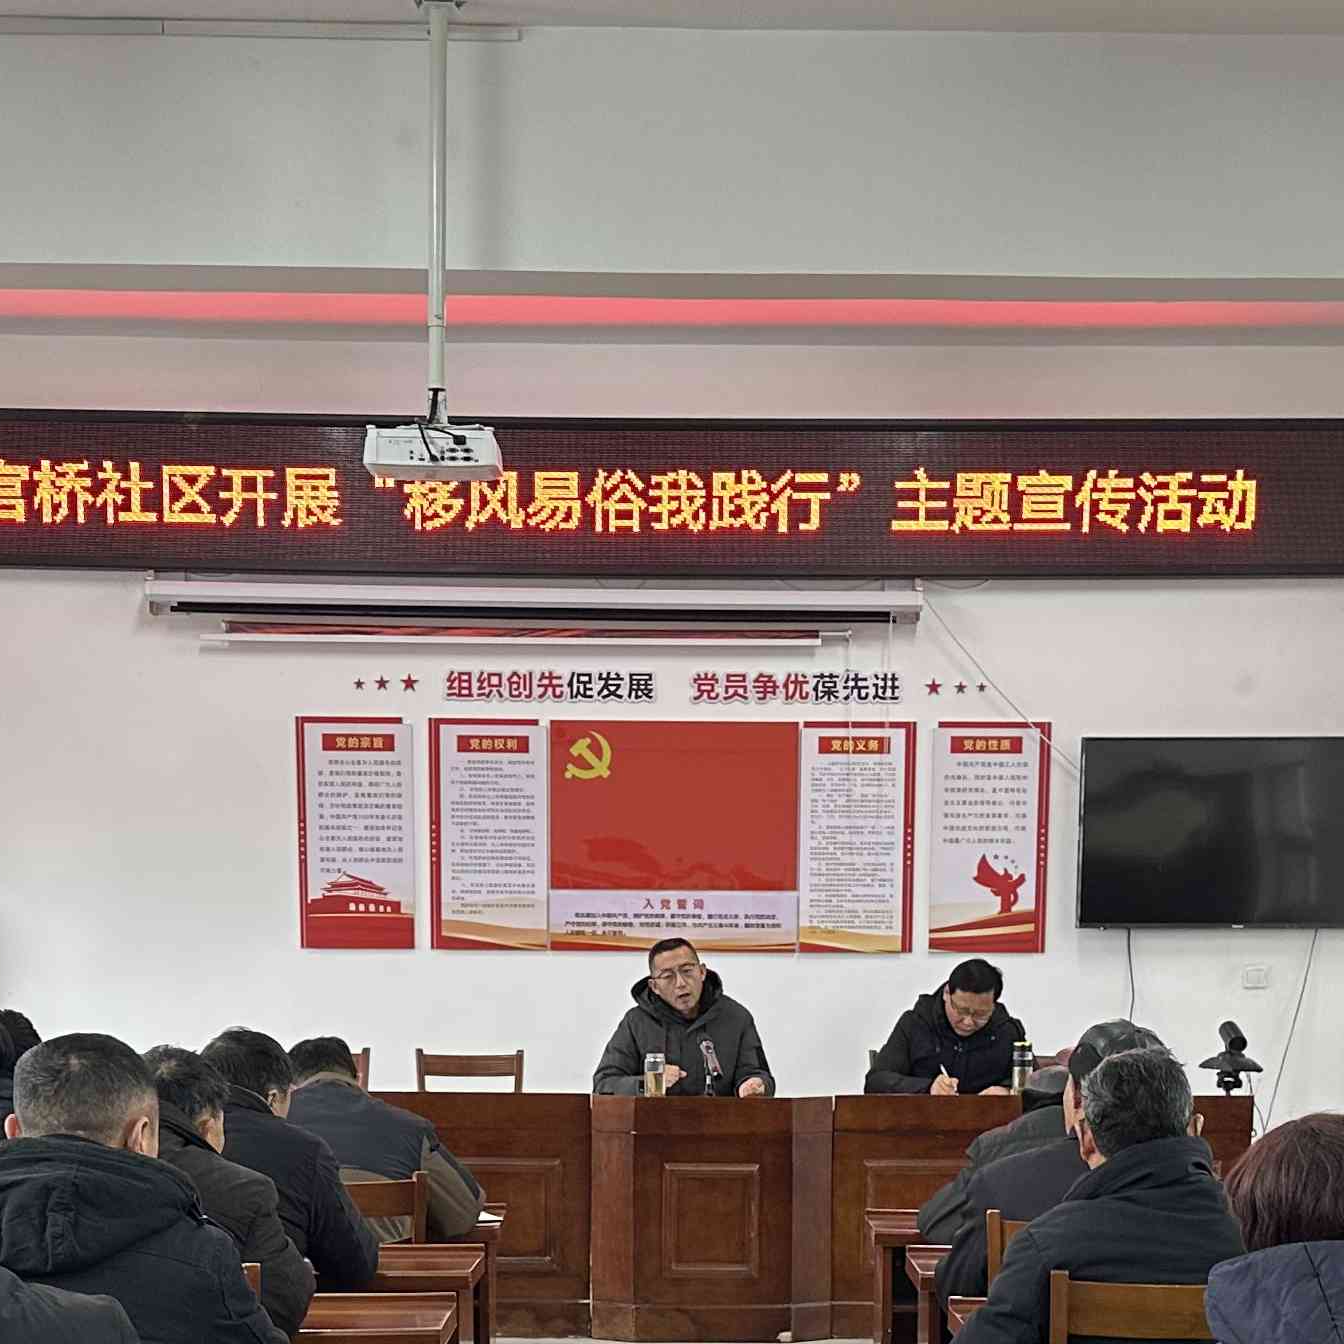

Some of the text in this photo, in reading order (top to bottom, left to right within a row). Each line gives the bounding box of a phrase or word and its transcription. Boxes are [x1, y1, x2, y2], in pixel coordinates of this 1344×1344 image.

[445, 670, 901, 703] 组织创先促发展 党员争优葆先进
[335, 737, 385, 749] 党的宗旨
[469, 738, 518, 750] 党的权利
[830, 739, 879, 751] 党的义务
[962, 739, 1012, 751] 党的性质
[642, 898, 705, 910] 入党誓词
